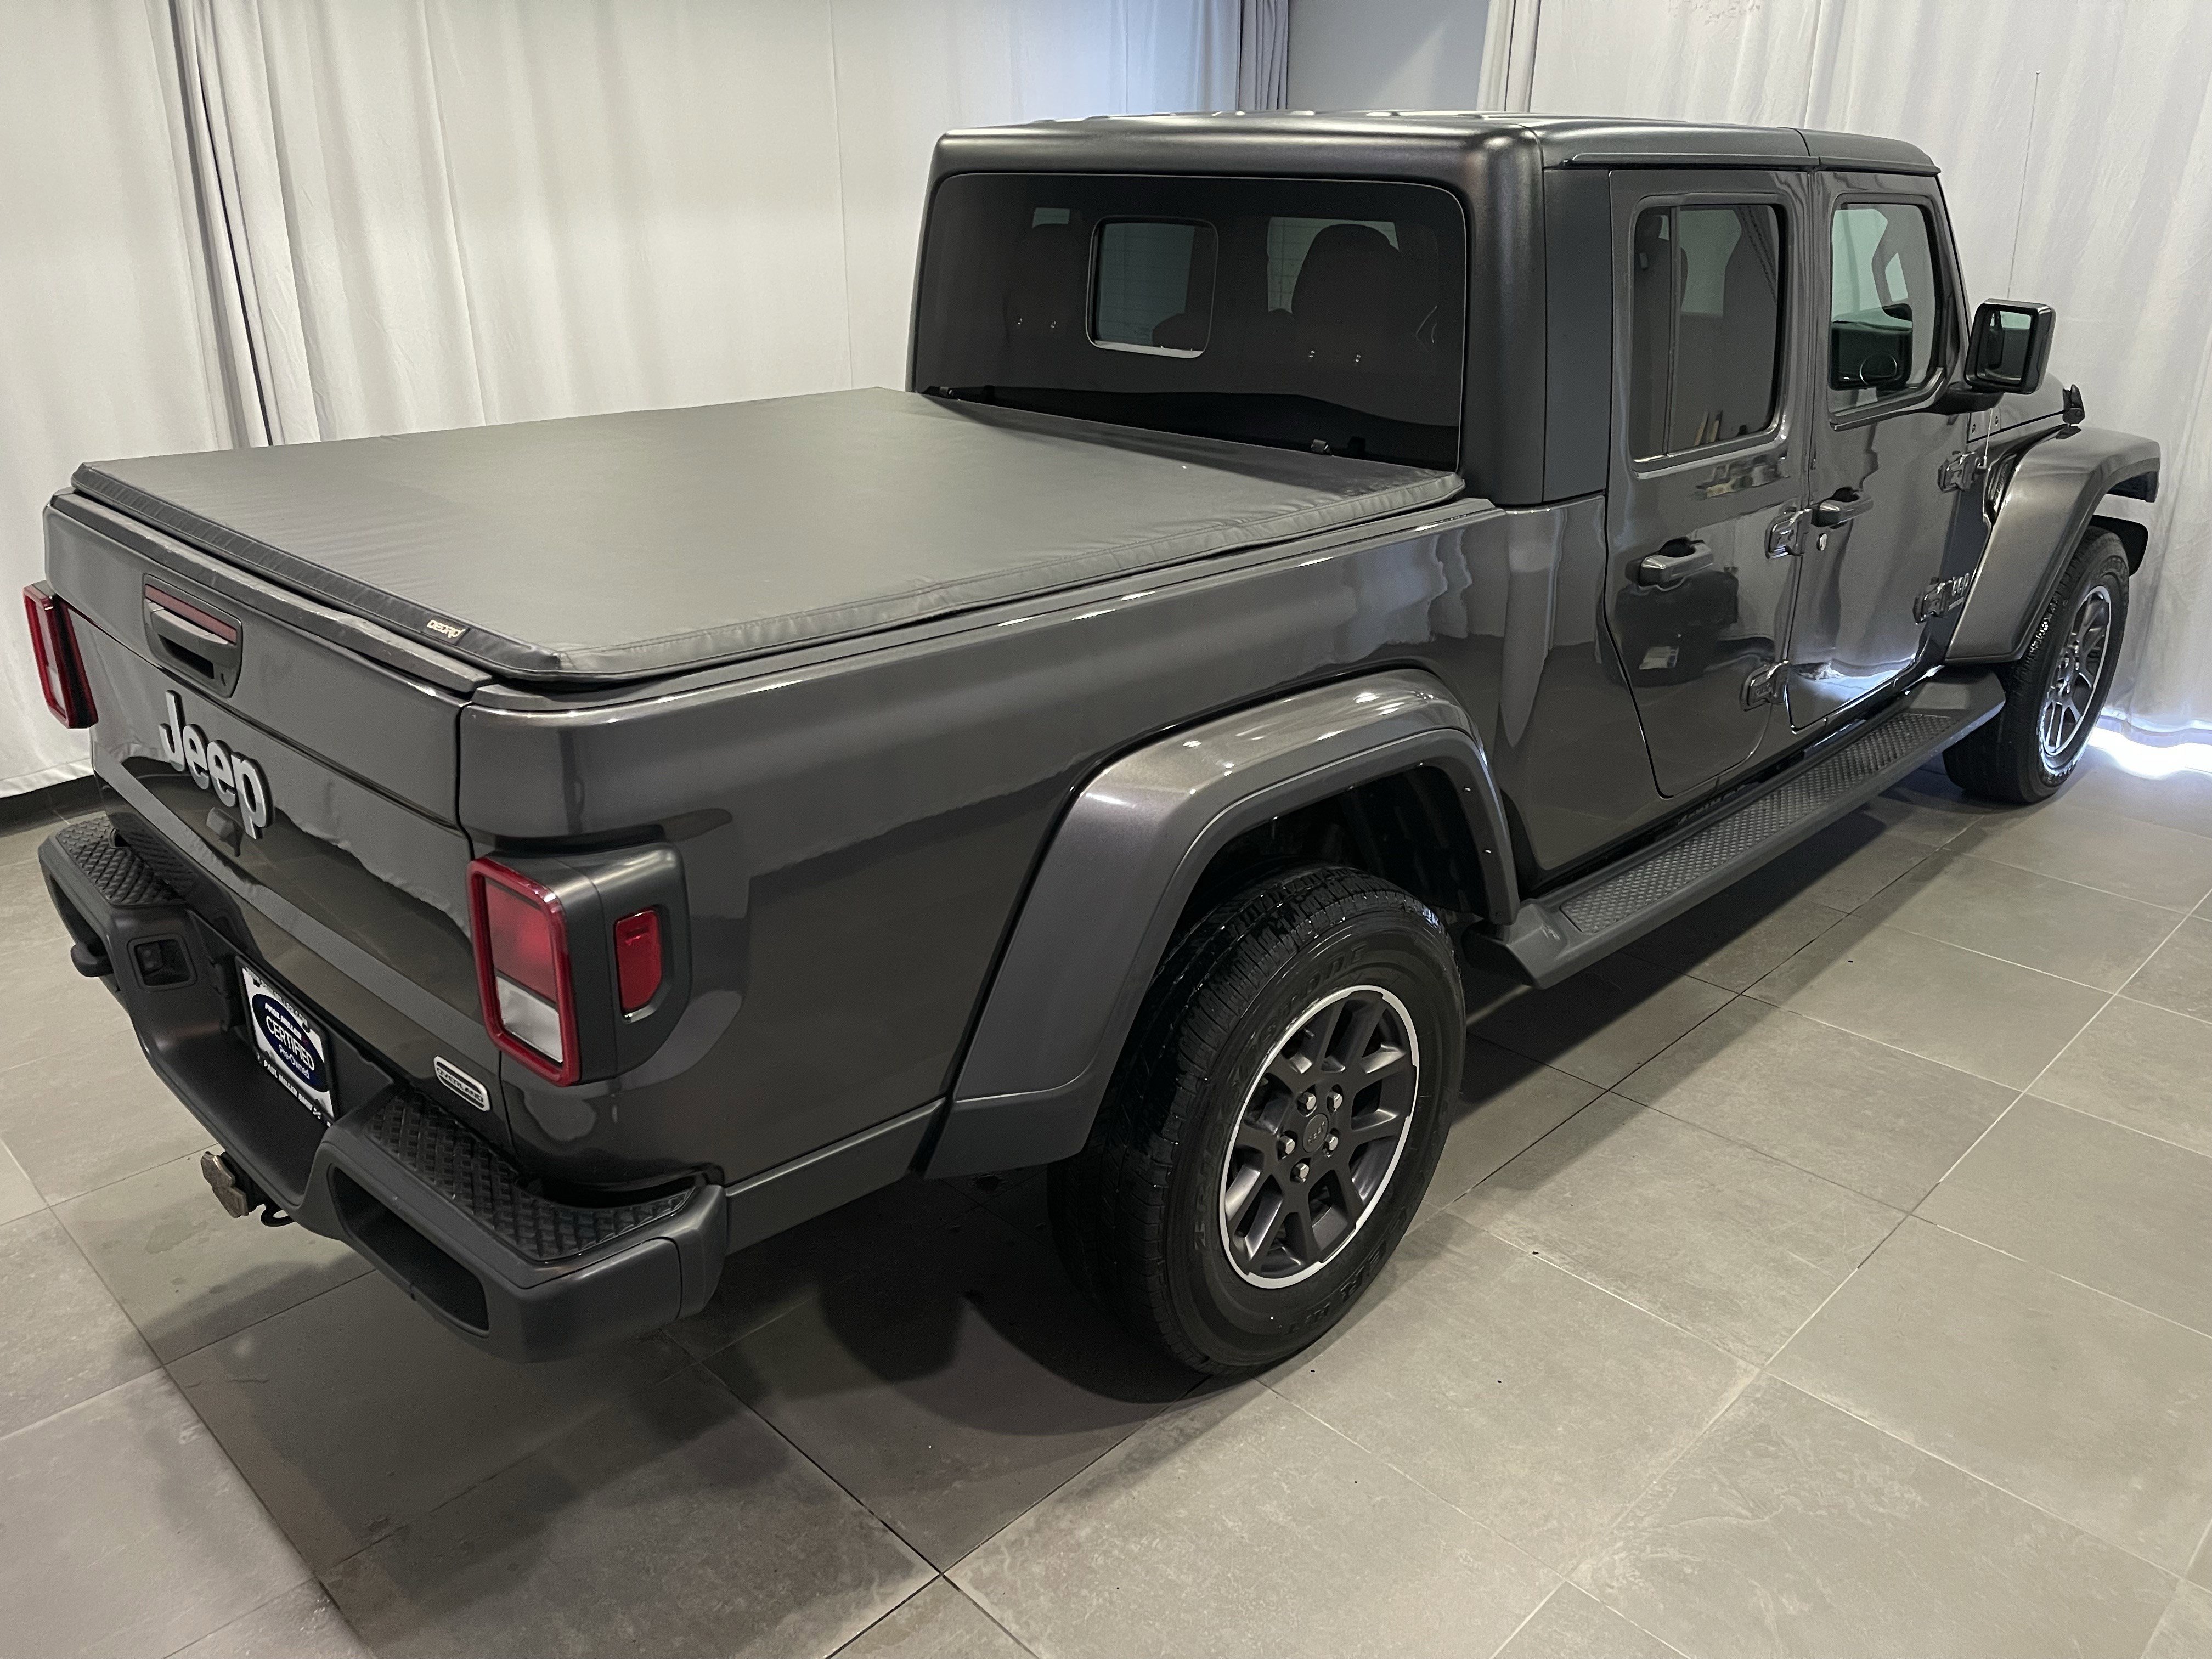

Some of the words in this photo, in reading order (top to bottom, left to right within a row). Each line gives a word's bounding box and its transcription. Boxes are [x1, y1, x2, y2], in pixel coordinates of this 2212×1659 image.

[158, 690, 273, 839] Jeep
[266, 1015, 315, 1070] CERTIFIED
[278, 1043, 311, 1080] Pre-Owned
[437, 1066, 484, 1103] OVERLAND
